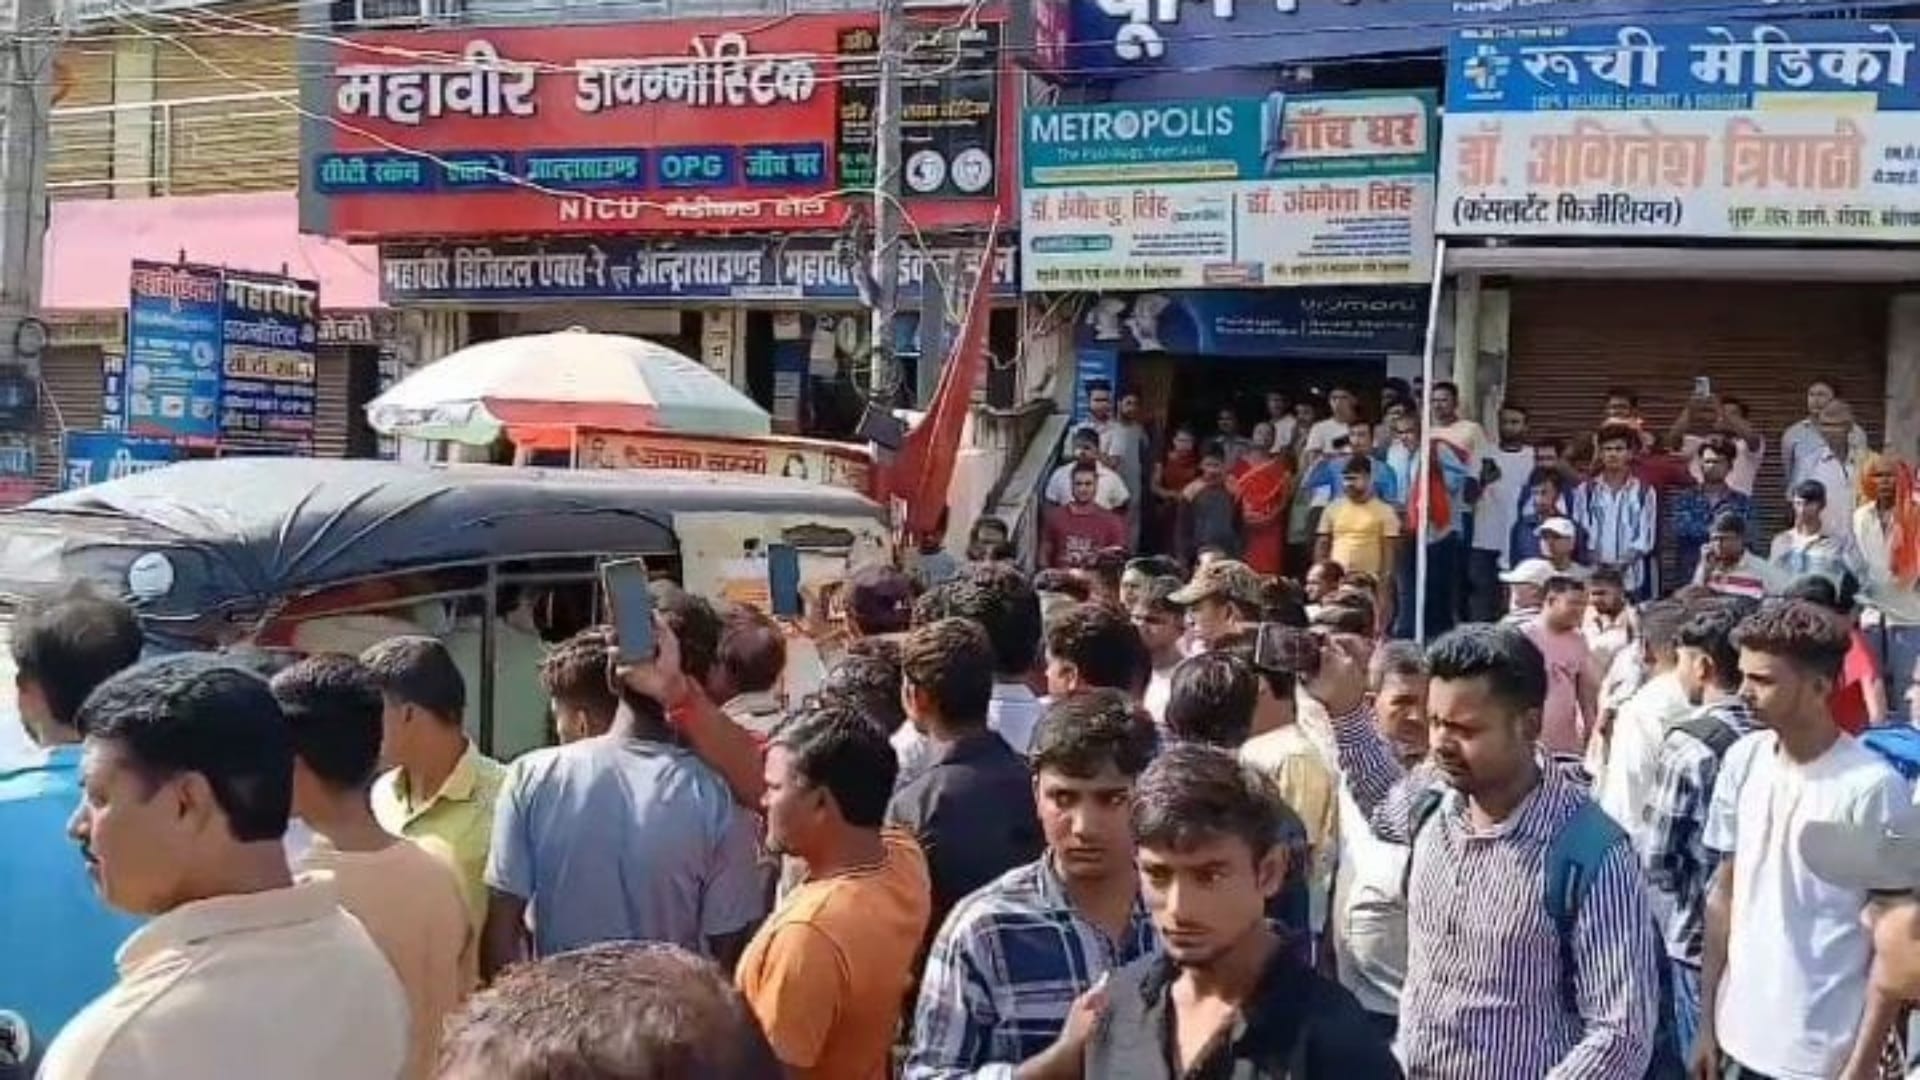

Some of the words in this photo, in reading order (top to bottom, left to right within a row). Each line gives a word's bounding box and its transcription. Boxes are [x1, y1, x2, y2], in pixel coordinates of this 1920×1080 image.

[336, 42, 535, 123] महावीर
[1031, 106, 1234, 144] METROPOLIS
[660, 154, 723, 178] OPG
[559, 197, 641, 221] NICU
